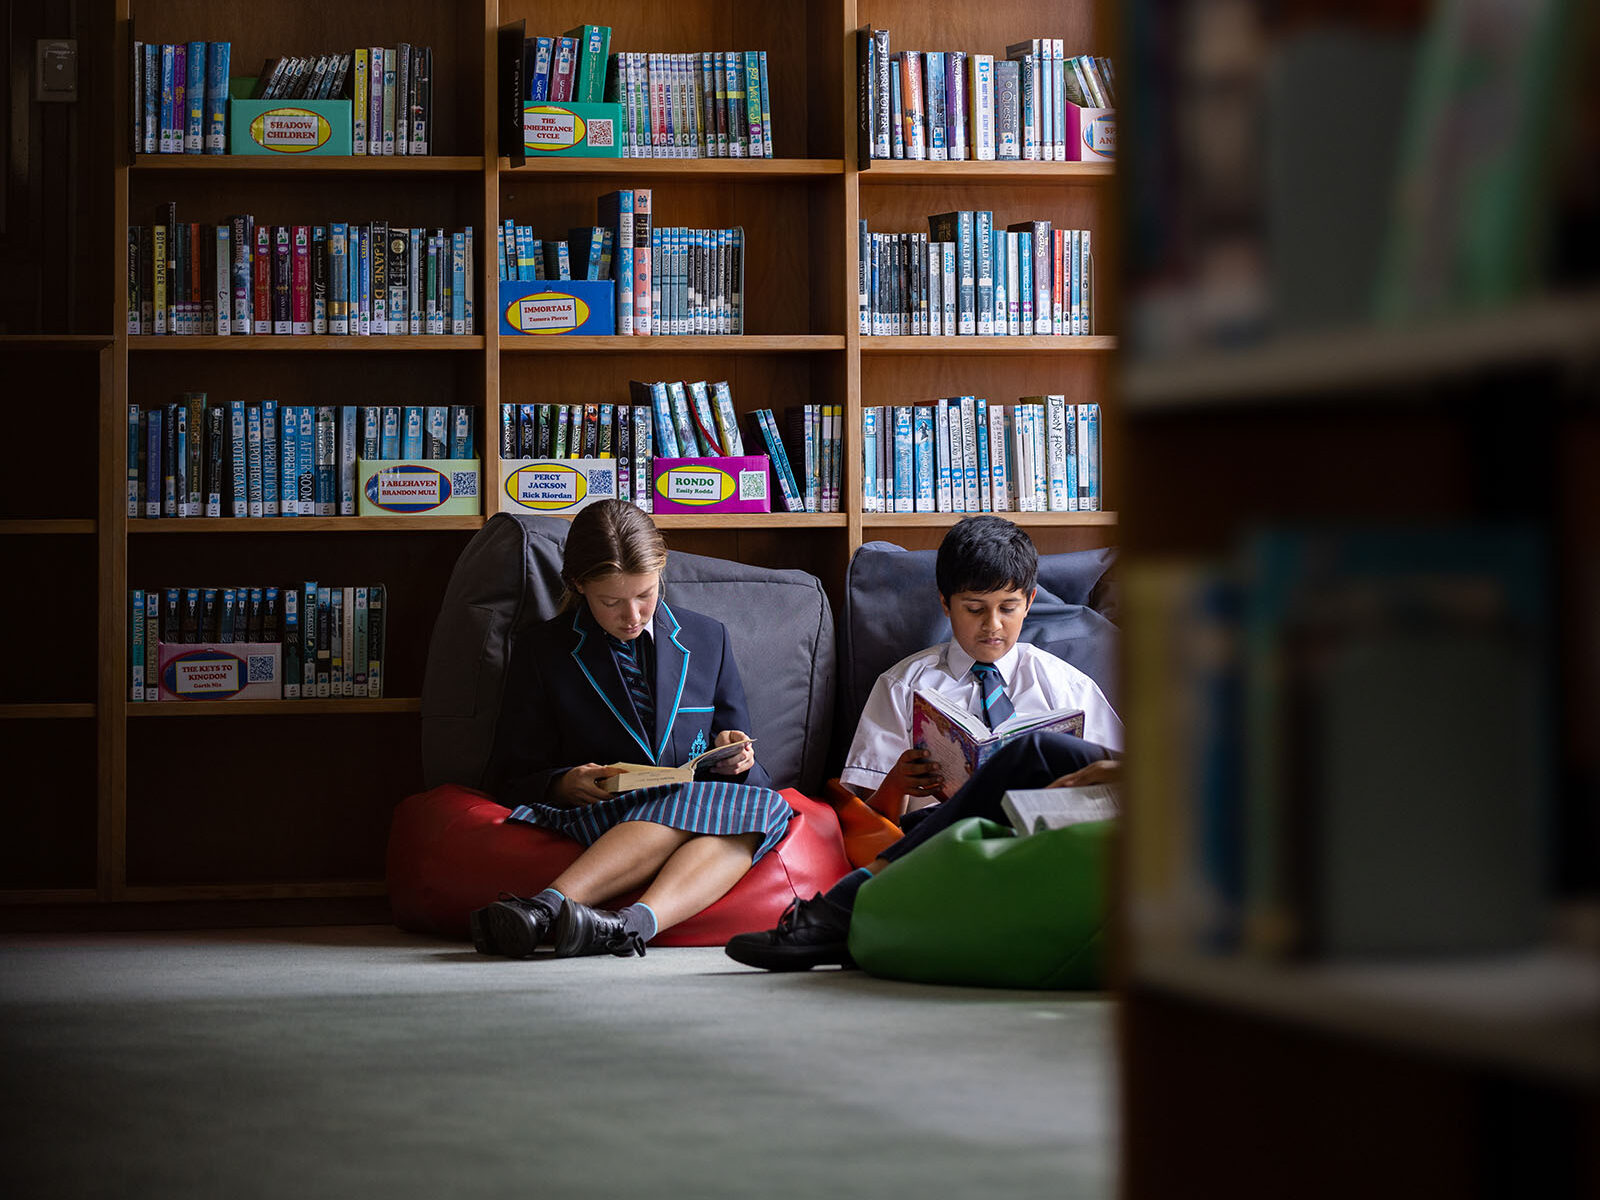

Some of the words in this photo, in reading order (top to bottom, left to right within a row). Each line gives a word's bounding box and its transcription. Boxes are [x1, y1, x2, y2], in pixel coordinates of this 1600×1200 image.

[879, 56, 889, 90] HARRY
[512, 57, 521, 128] Fantasy
[535, 79, 545, 101] ERA
[558, 79, 566, 101] ELD
[879, 92, 889, 131] POTTER
[266, 131, 316, 139] CHILDREN
[270, 121, 313, 129] SHADOW
[637, 133, 643, 145] 9
[645, 132, 651, 145] 8
[652, 133, 659, 145] 7
[660, 132, 667, 144] 6
[668, 133, 674, 145] 5
[682, 133, 689, 145] 3
[691, 133, 697, 145] 2
[963, 223, 971, 258] EMERALD
[157, 257, 165, 285] TOWER
[374, 248, 384, 284] JANE
[524, 304, 572, 313] IMMORTALS
[324, 425, 334, 459] KEEPER
[232, 434, 245, 498] APOTHECARY
[300, 440, 312, 471] AFTER
[250, 442, 261, 501] APOTHECARY
[264, 438, 276, 500] APPRENTICES
[284, 439, 296, 501] APPRENTICES
[300, 472, 312, 502] ROOM
[675, 478, 714, 486] RONDO
